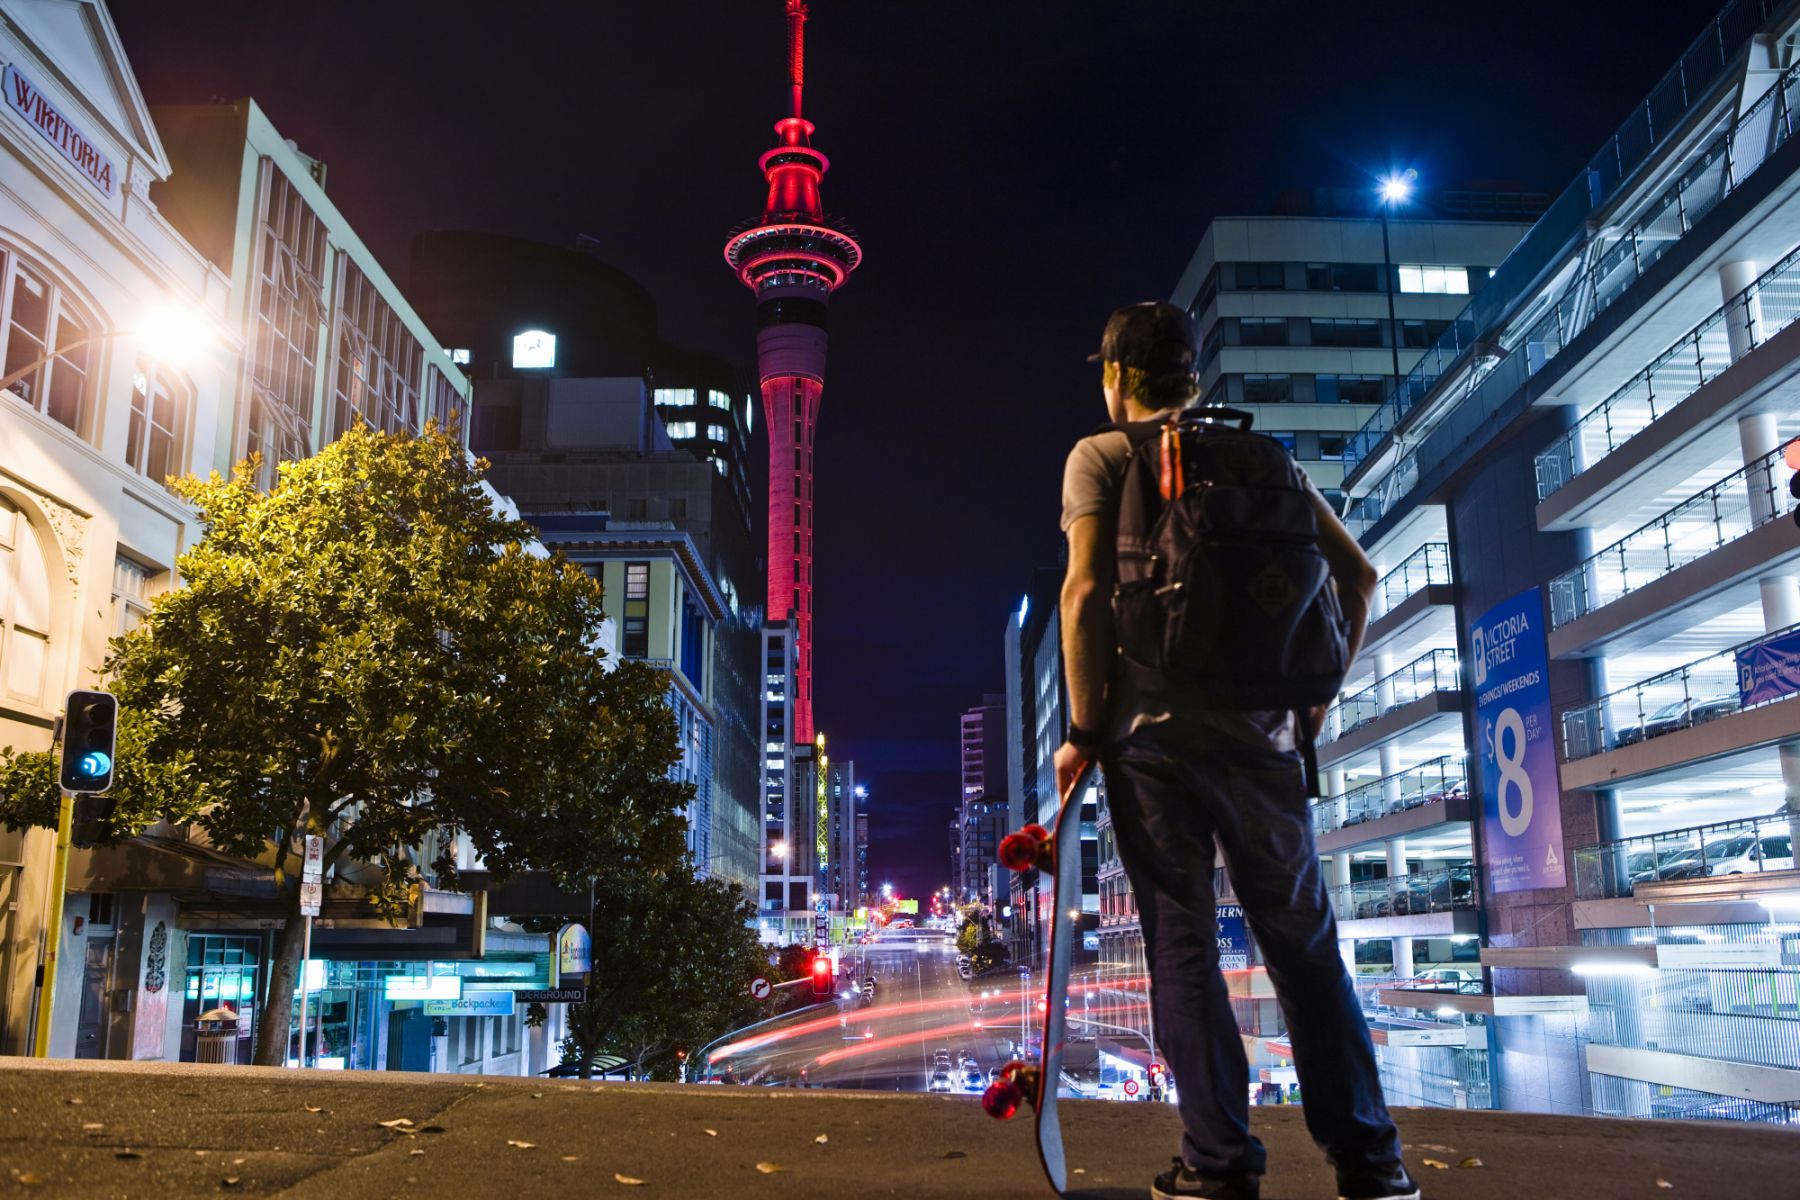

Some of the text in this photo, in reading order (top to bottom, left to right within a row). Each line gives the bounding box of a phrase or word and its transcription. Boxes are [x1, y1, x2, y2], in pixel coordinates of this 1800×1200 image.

[13, 70, 112, 193] WIKITORIA
[1484, 611, 1530, 649] VICTORIA
[1486, 637, 1516, 670] STREET
[1479, 671, 1540, 707] EVENINGS/WEEKENDS
[1525, 713, 1538, 727] PER
